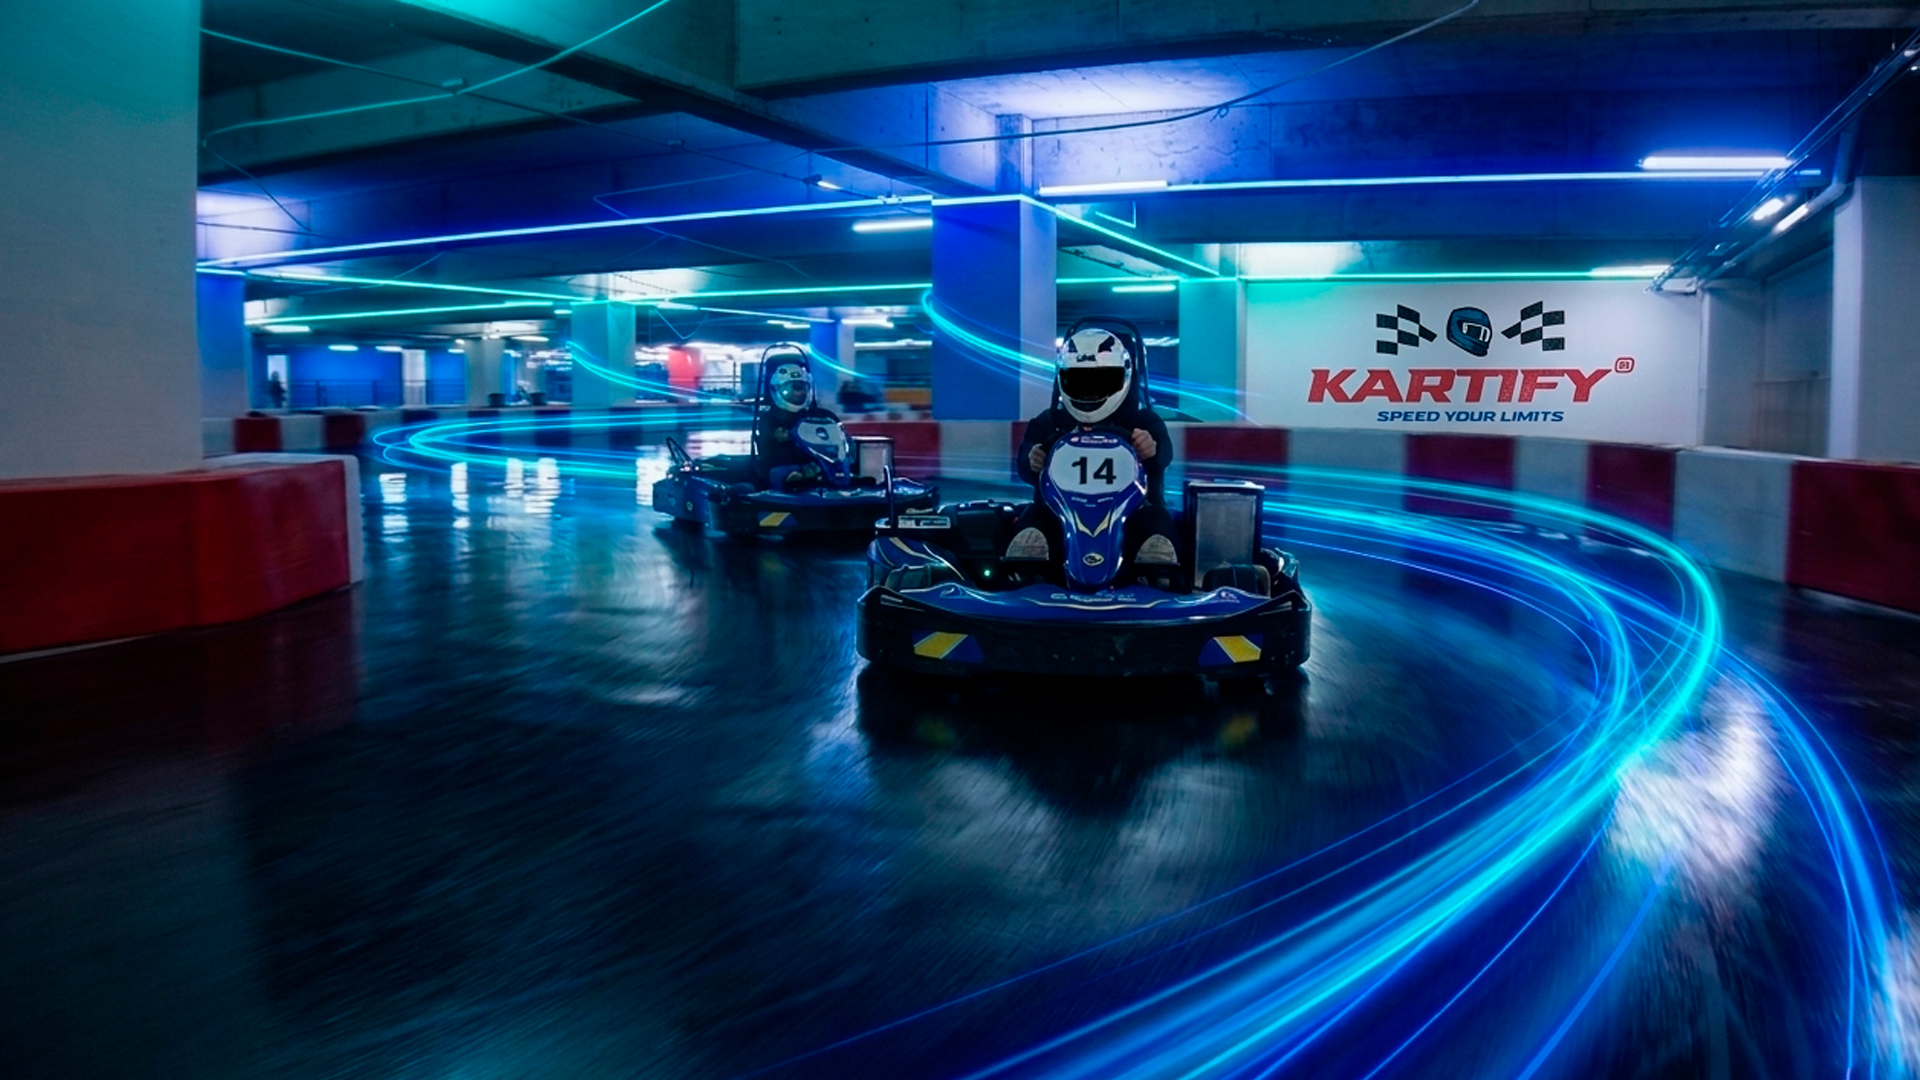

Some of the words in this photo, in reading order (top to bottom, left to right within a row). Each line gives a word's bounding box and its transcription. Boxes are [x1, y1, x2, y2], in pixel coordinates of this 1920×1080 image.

[1307, 368, 1612, 403] KARTIFY
[1376, 411, 1440, 422] SPEED
[1444, 411, 1497, 422] YOUR
[1500, 411, 1565, 422] LIMITS
[1071, 456, 1117, 485] 14
